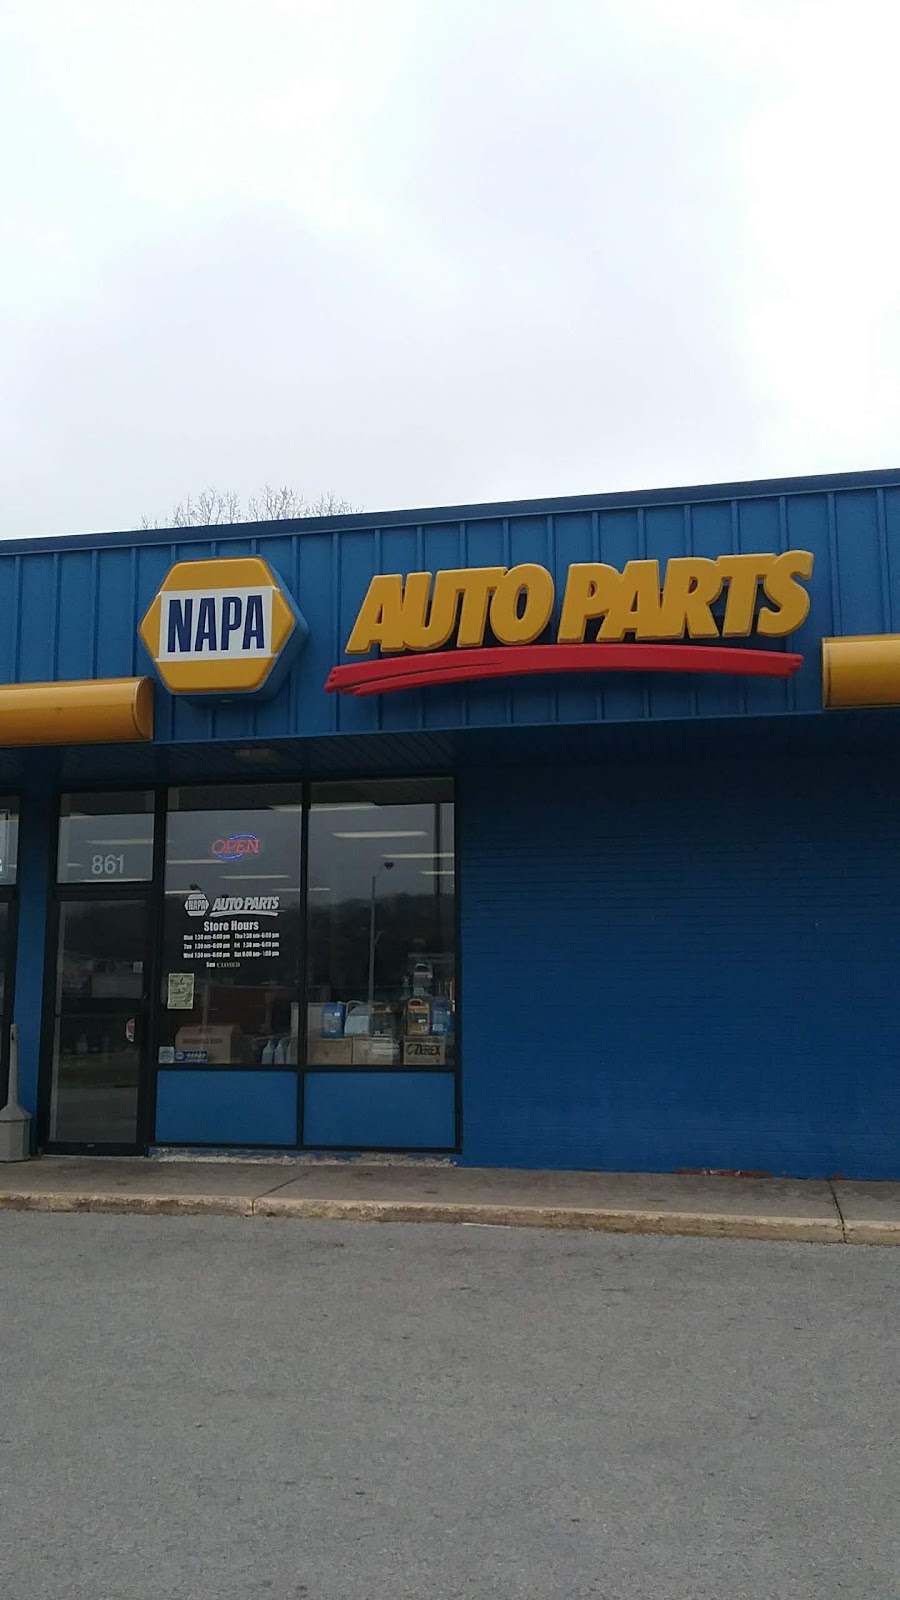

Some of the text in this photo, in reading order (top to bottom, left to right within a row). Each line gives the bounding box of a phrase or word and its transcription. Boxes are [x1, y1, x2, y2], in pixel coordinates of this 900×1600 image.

[345, 550, 814, 653] AUTO PARTS
[167, 595, 264, 653] NAPA
[211, 839, 261, 855] OPEN
[91, 854, 125, 875] 861
[212, 896, 279, 911] AUTO PARTS
[203, 920, 259, 932] Store Hours
